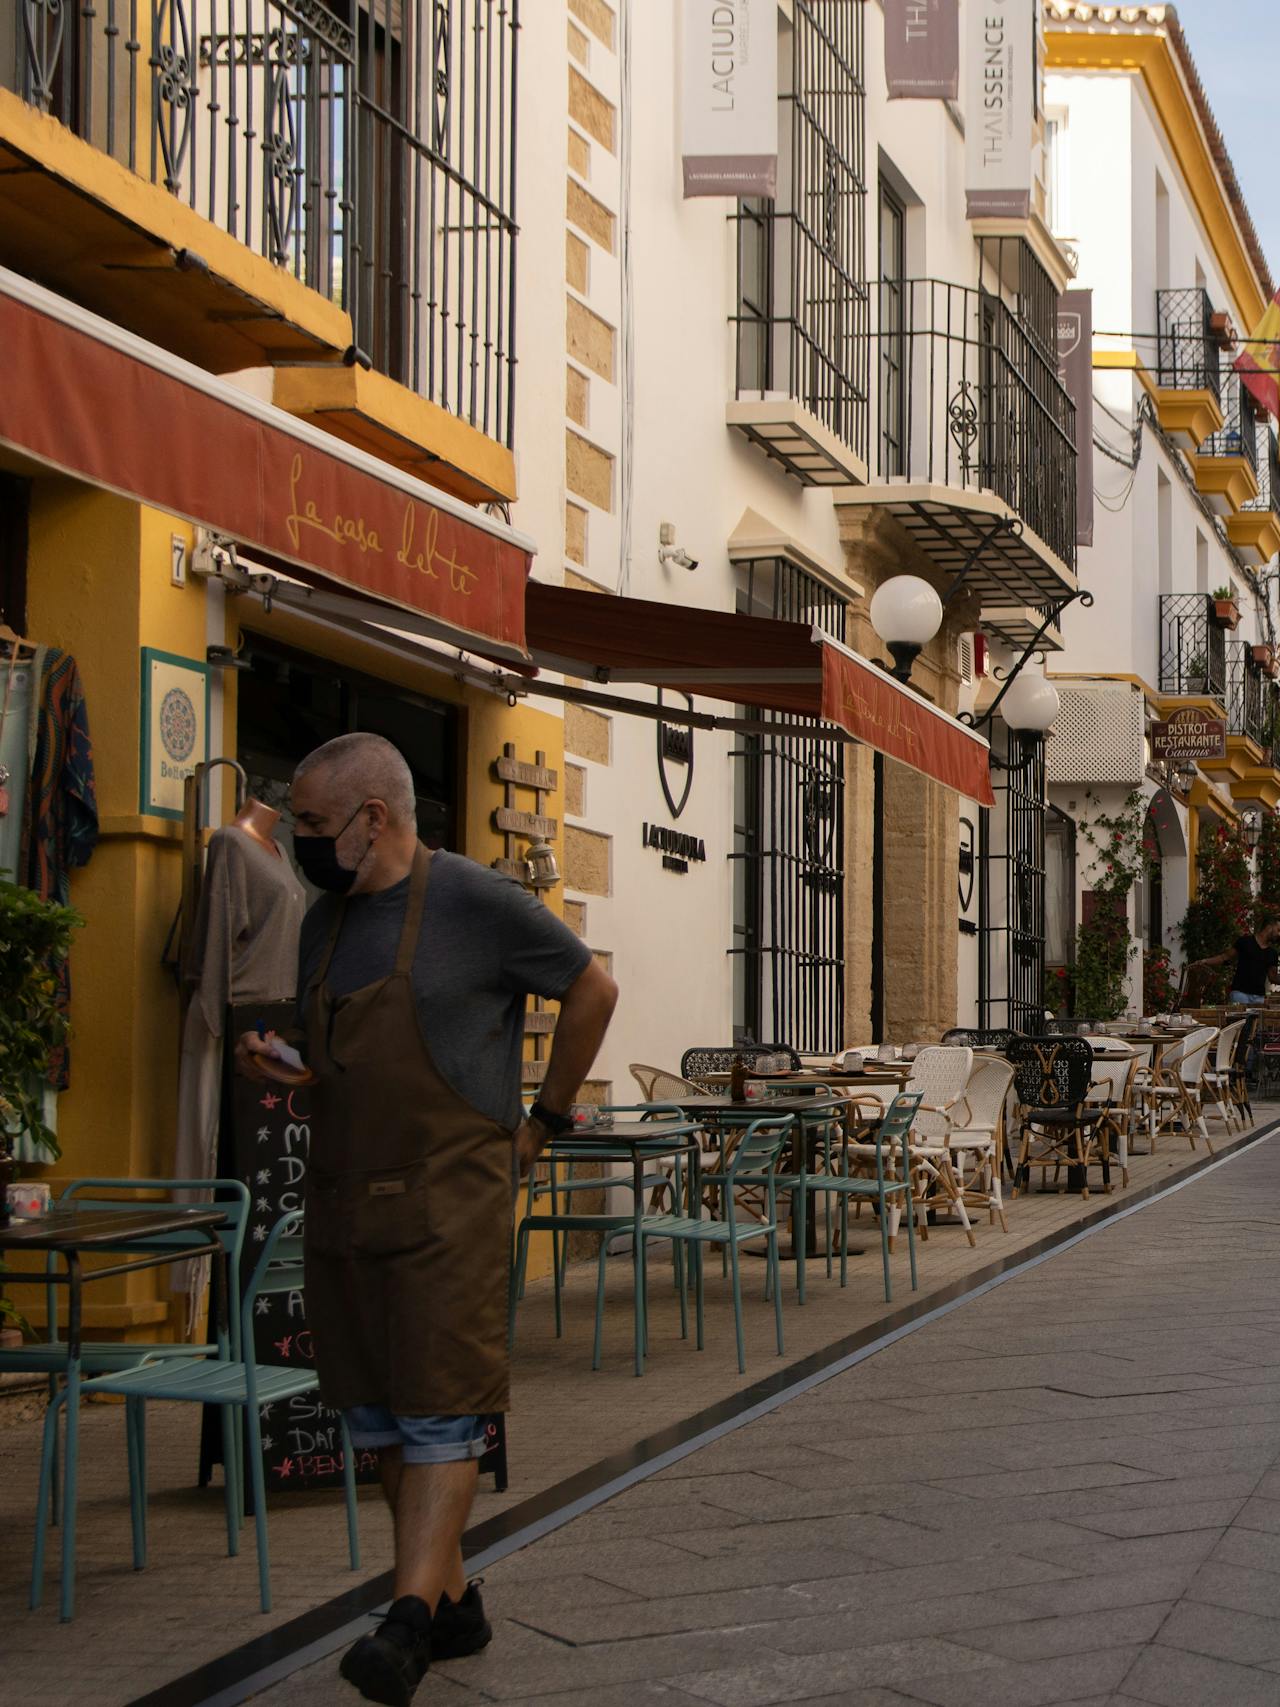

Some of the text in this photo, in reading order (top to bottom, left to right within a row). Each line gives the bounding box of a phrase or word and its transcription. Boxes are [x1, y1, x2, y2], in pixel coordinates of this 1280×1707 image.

[905, 0, 929, 43] TH
[984, 16, 1004, 168] THAISSENCE
[286, 453, 346, 550] La
[334, 515, 383, 553] casa
[397, 500, 439, 579] del
[173, 544, 185, 578] 7
[1155, 735, 1221, 748] RESTAURANTE
[1168, 723, 1208, 735] BISTROT
[1164, 746, 1210, 758] Casanis
